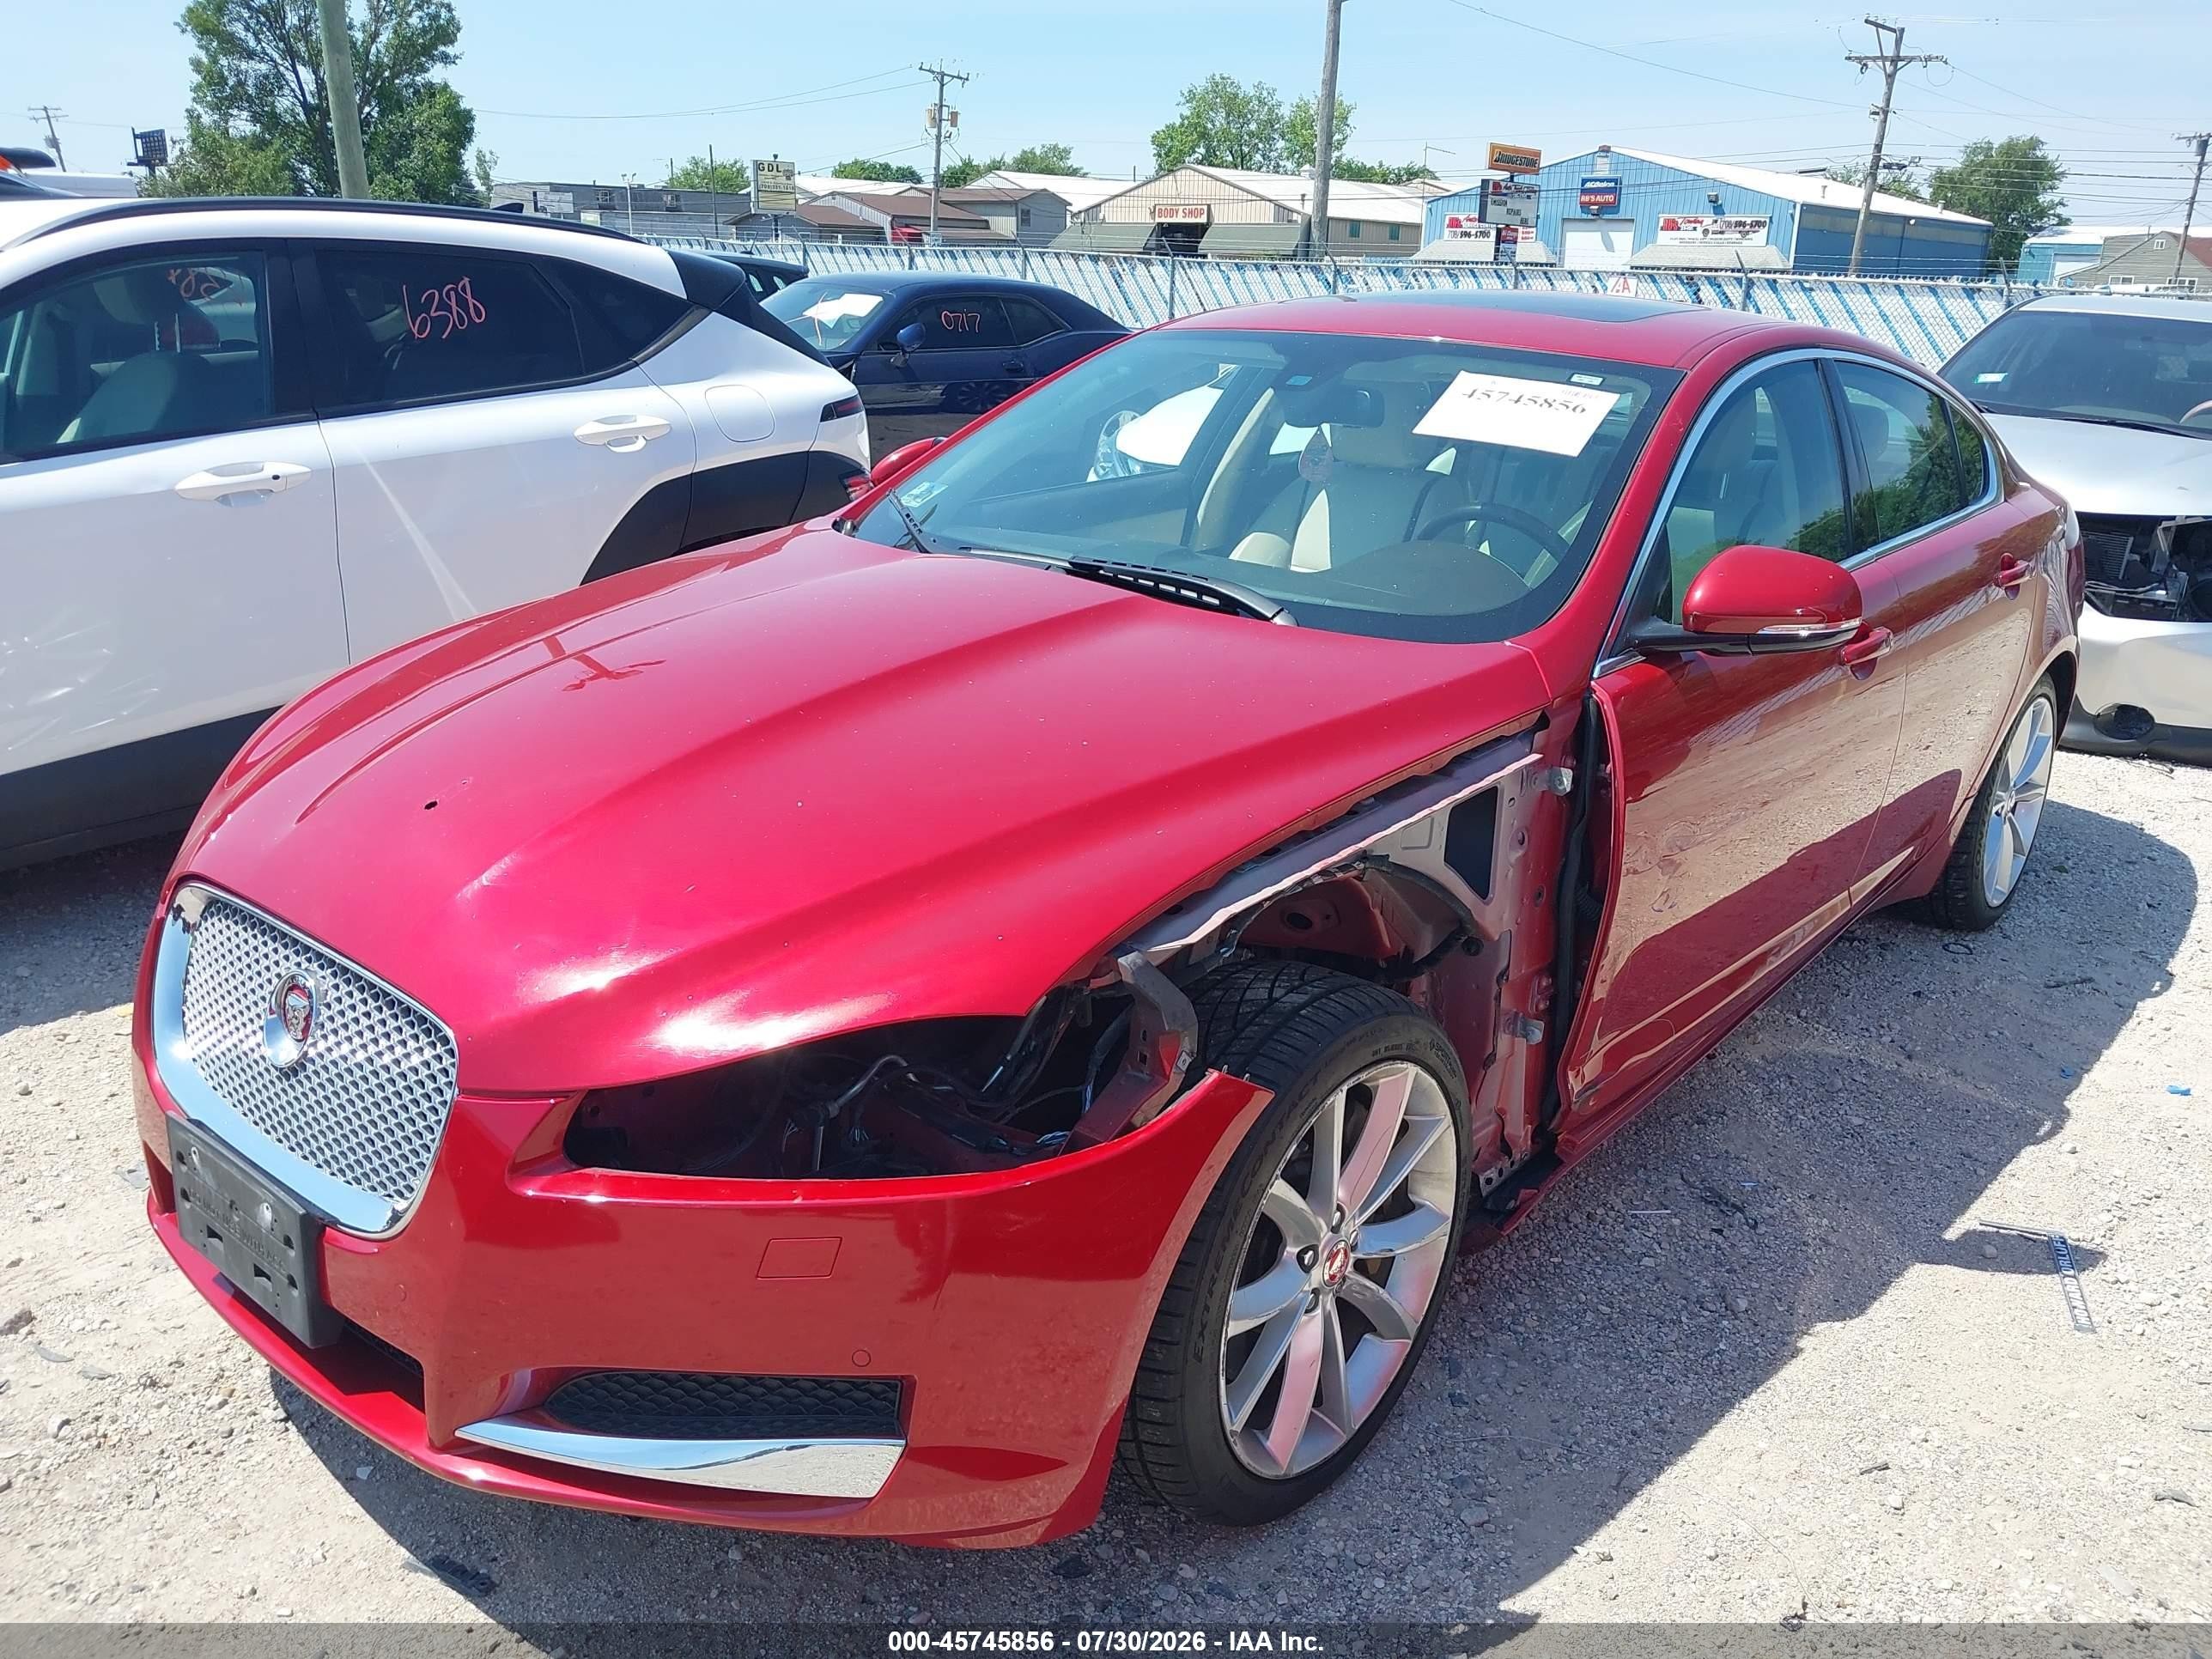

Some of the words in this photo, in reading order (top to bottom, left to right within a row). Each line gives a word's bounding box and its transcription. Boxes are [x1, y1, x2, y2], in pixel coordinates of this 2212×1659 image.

[1494, 150, 1538, 168] BRIDGESTONE
[1158, 207, 1179, 219] BODY
[1182, 207, 1205, 219] SHOP
[403, 275, 487, 339] 6388
[940, 308, 981, 333] 0717
[1462, 388, 1588, 414] 45745856
